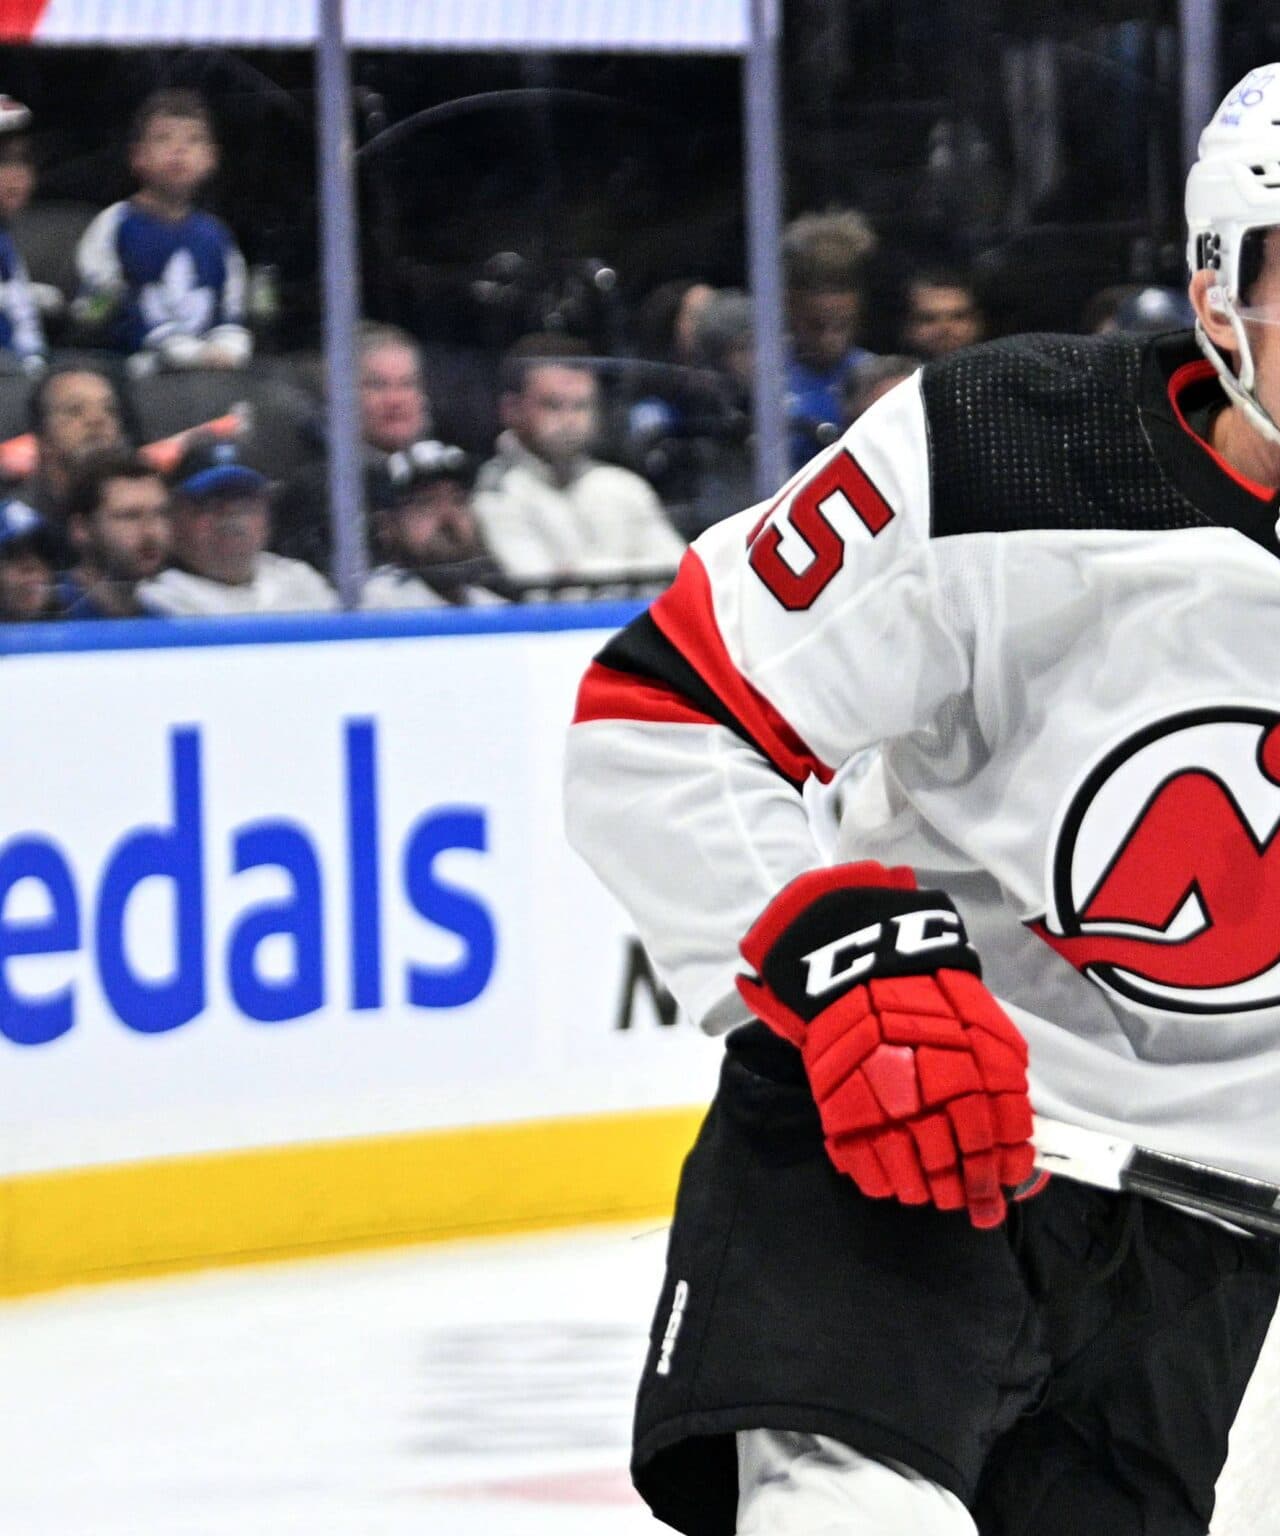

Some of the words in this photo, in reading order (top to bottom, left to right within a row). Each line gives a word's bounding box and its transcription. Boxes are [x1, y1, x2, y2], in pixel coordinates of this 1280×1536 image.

[745, 446, 896, 612] 5
[0, 716, 497, 1046] edals
[800, 909, 976, 997] CC
